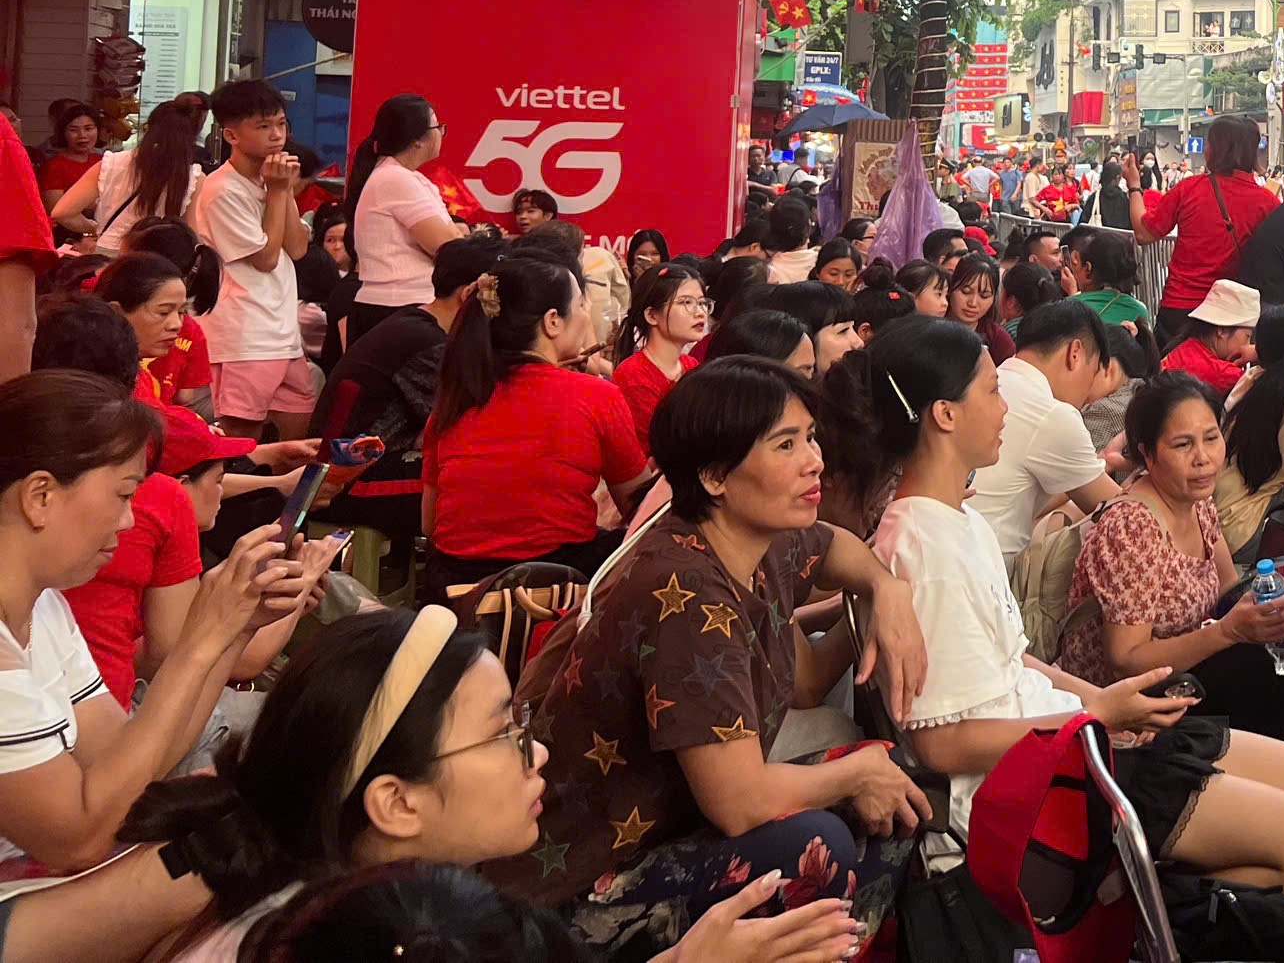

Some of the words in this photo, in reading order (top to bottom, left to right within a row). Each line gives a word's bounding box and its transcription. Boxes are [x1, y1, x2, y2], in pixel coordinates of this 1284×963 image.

[309, 5, 340, 18] THÁI
[496, 83, 625, 111] viettel
[464, 119, 624, 215] 5G
